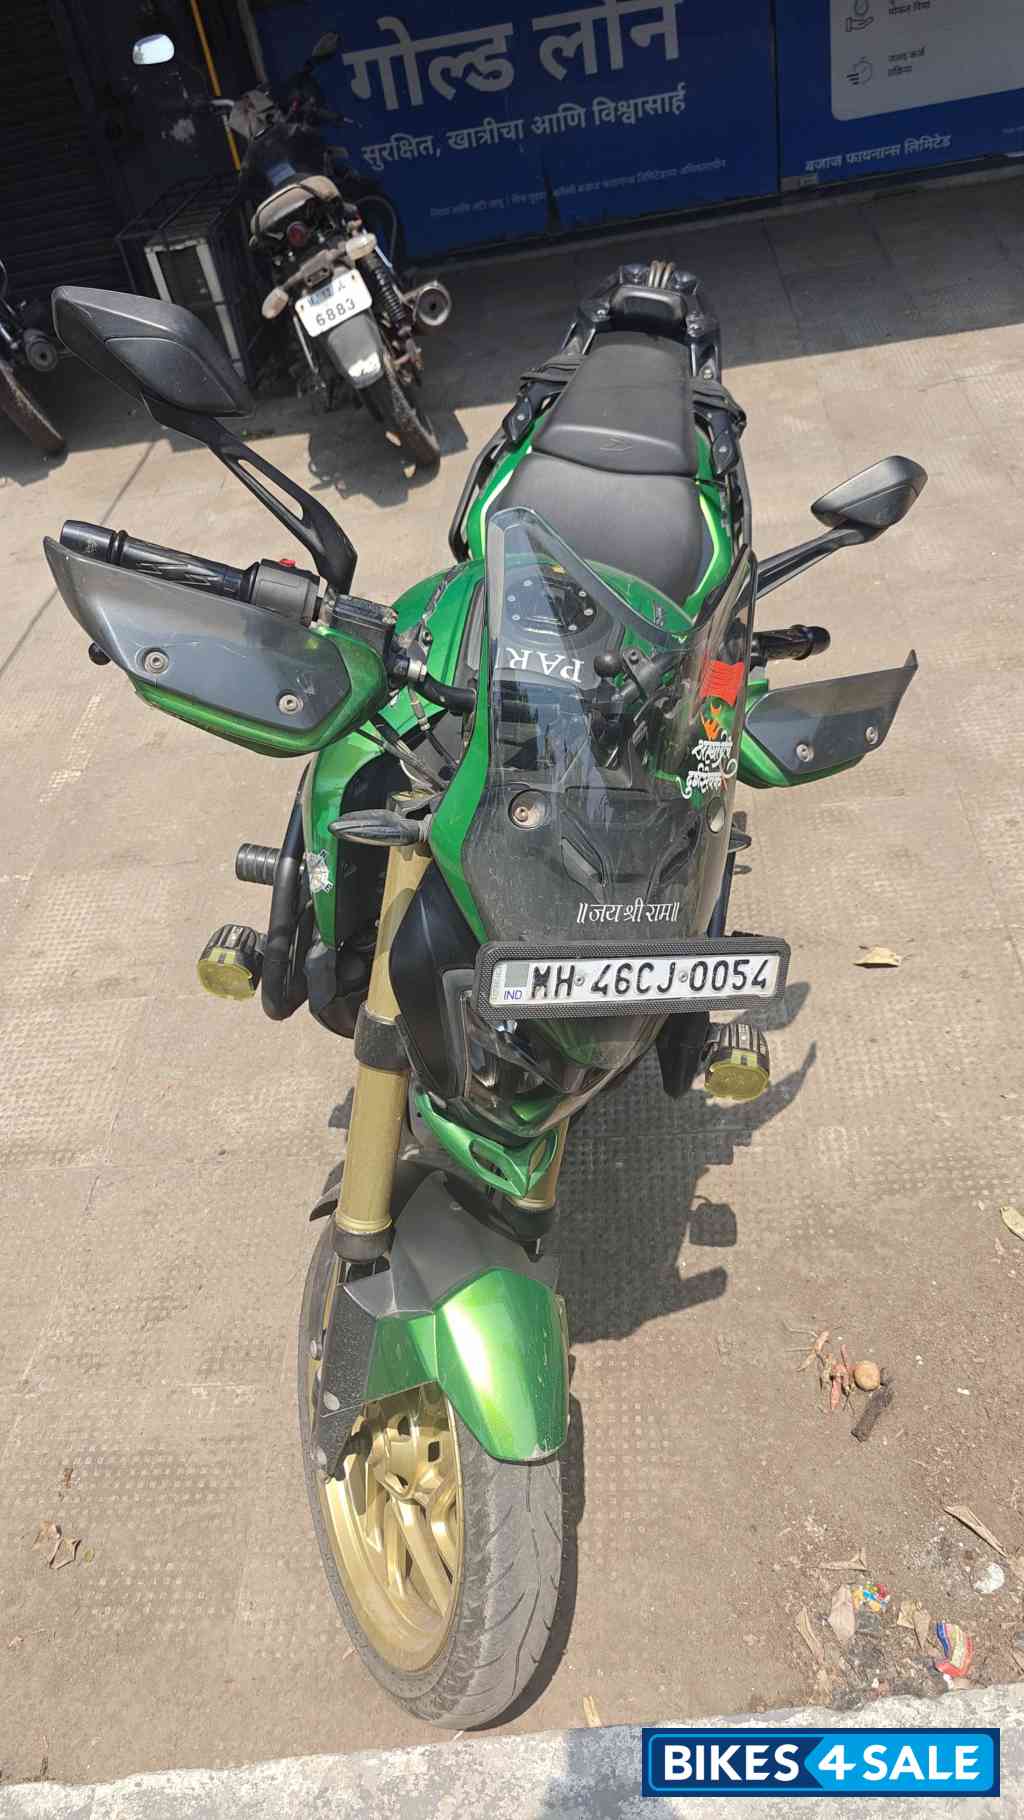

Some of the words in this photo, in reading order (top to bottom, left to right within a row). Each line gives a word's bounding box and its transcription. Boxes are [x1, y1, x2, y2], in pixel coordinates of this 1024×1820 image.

[342, 16, 515, 111] गोल्ड
[361, 132, 441, 171] सुरक्षित,
[447, 117, 525, 152] खात्रीचा
[531, 103, 587, 135] आणि
[593, 82, 687, 124] विश्वासार्ह
[903, 134, 953, 155] लिमिटेड
[316, 298, 356, 326] 6883
[624, 896, 644, 923] श्री
[531, 964, 575, 999] MH
[590, 961, 677, 997] 46CJ
[689, 958, 770, 992] 0054
[503, 989, 523, 1000] IND
